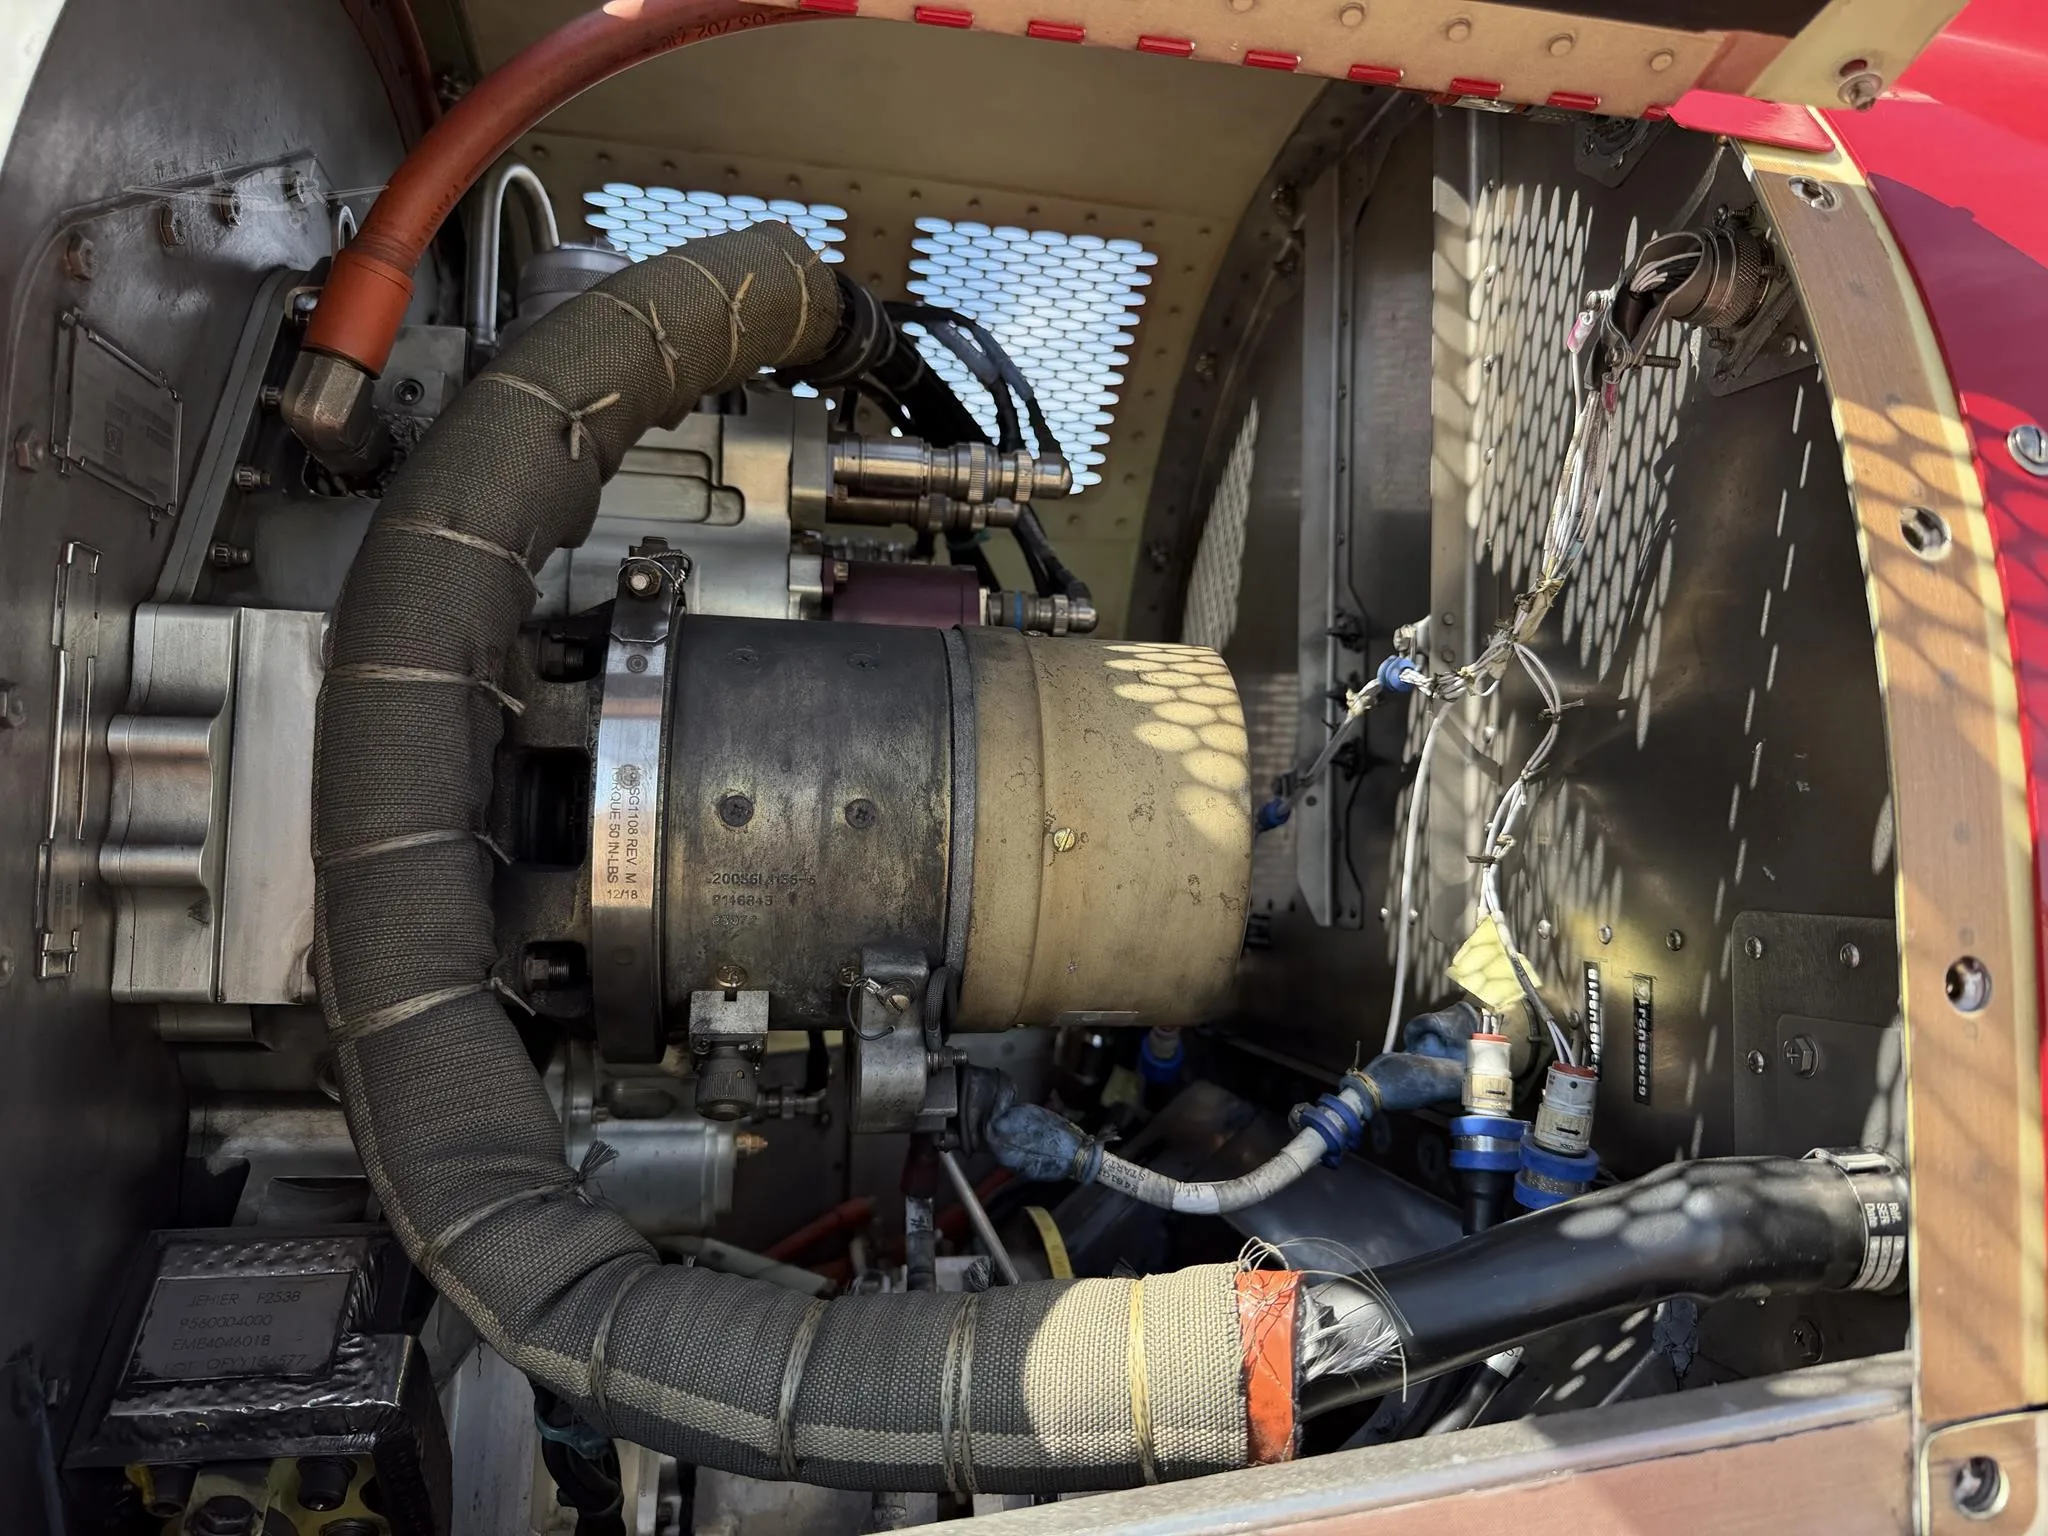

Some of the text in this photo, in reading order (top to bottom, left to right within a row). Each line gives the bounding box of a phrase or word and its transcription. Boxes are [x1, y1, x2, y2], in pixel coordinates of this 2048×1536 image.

[609, 824, 620, 838] 50
[607, 842, 619, 883] IN-LBS
[626, 873, 637, 884] M
[607, 889, 638, 900] 12/18
[186, 1293, 240, 1307] JEHIER
